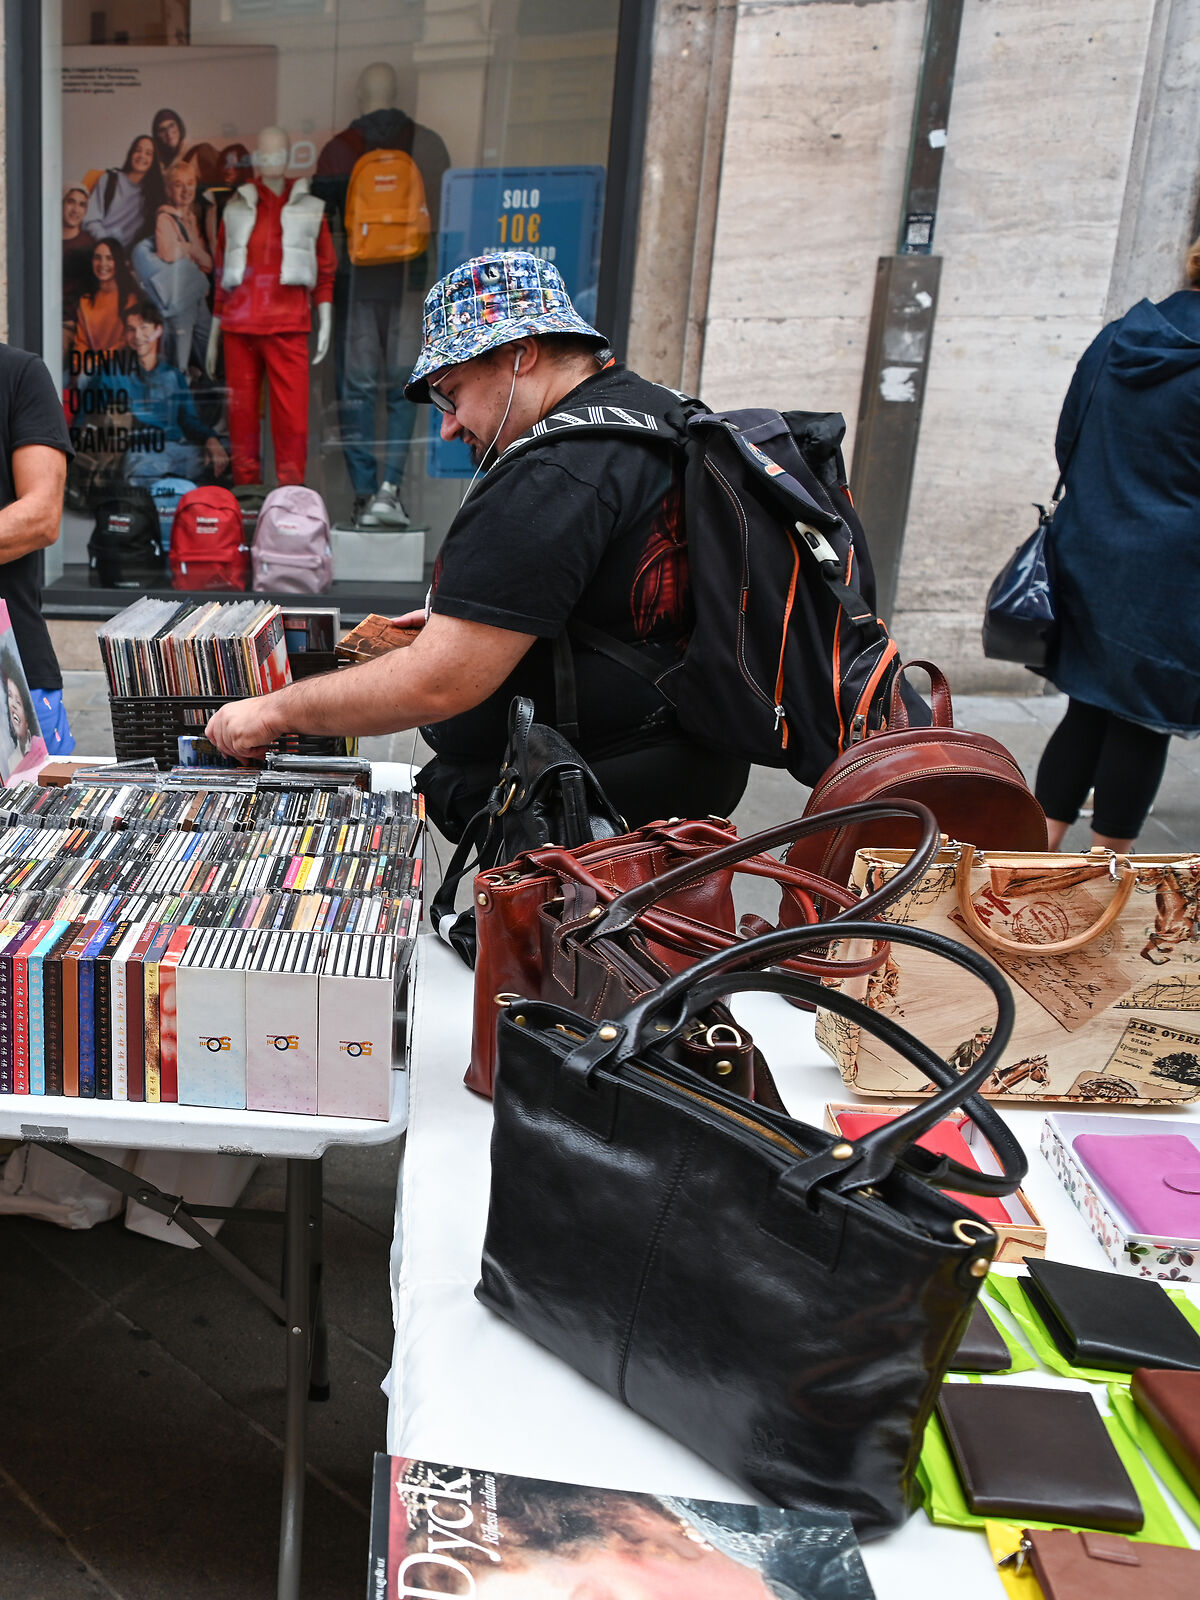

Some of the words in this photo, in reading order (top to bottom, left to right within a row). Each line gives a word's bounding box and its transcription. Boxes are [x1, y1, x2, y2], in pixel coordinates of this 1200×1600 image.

[503, 188, 540, 209] SOLO
[497, 213, 541, 243] 10€
[68, 350, 141, 376] DONNA
[69, 389, 129, 415] UOMO
[70, 426, 166, 453] BAMBINO
[1128, 1021, 1157, 1034] THE
[1131, 1038, 1152, 1047] GREAT
[1097, 1089, 1119, 1097] PAID
[479, 1473, 497, 1510] italiani
[395, 1468, 502, 1600] Dyck
[480, 1510, 504, 1545] Riflessi
